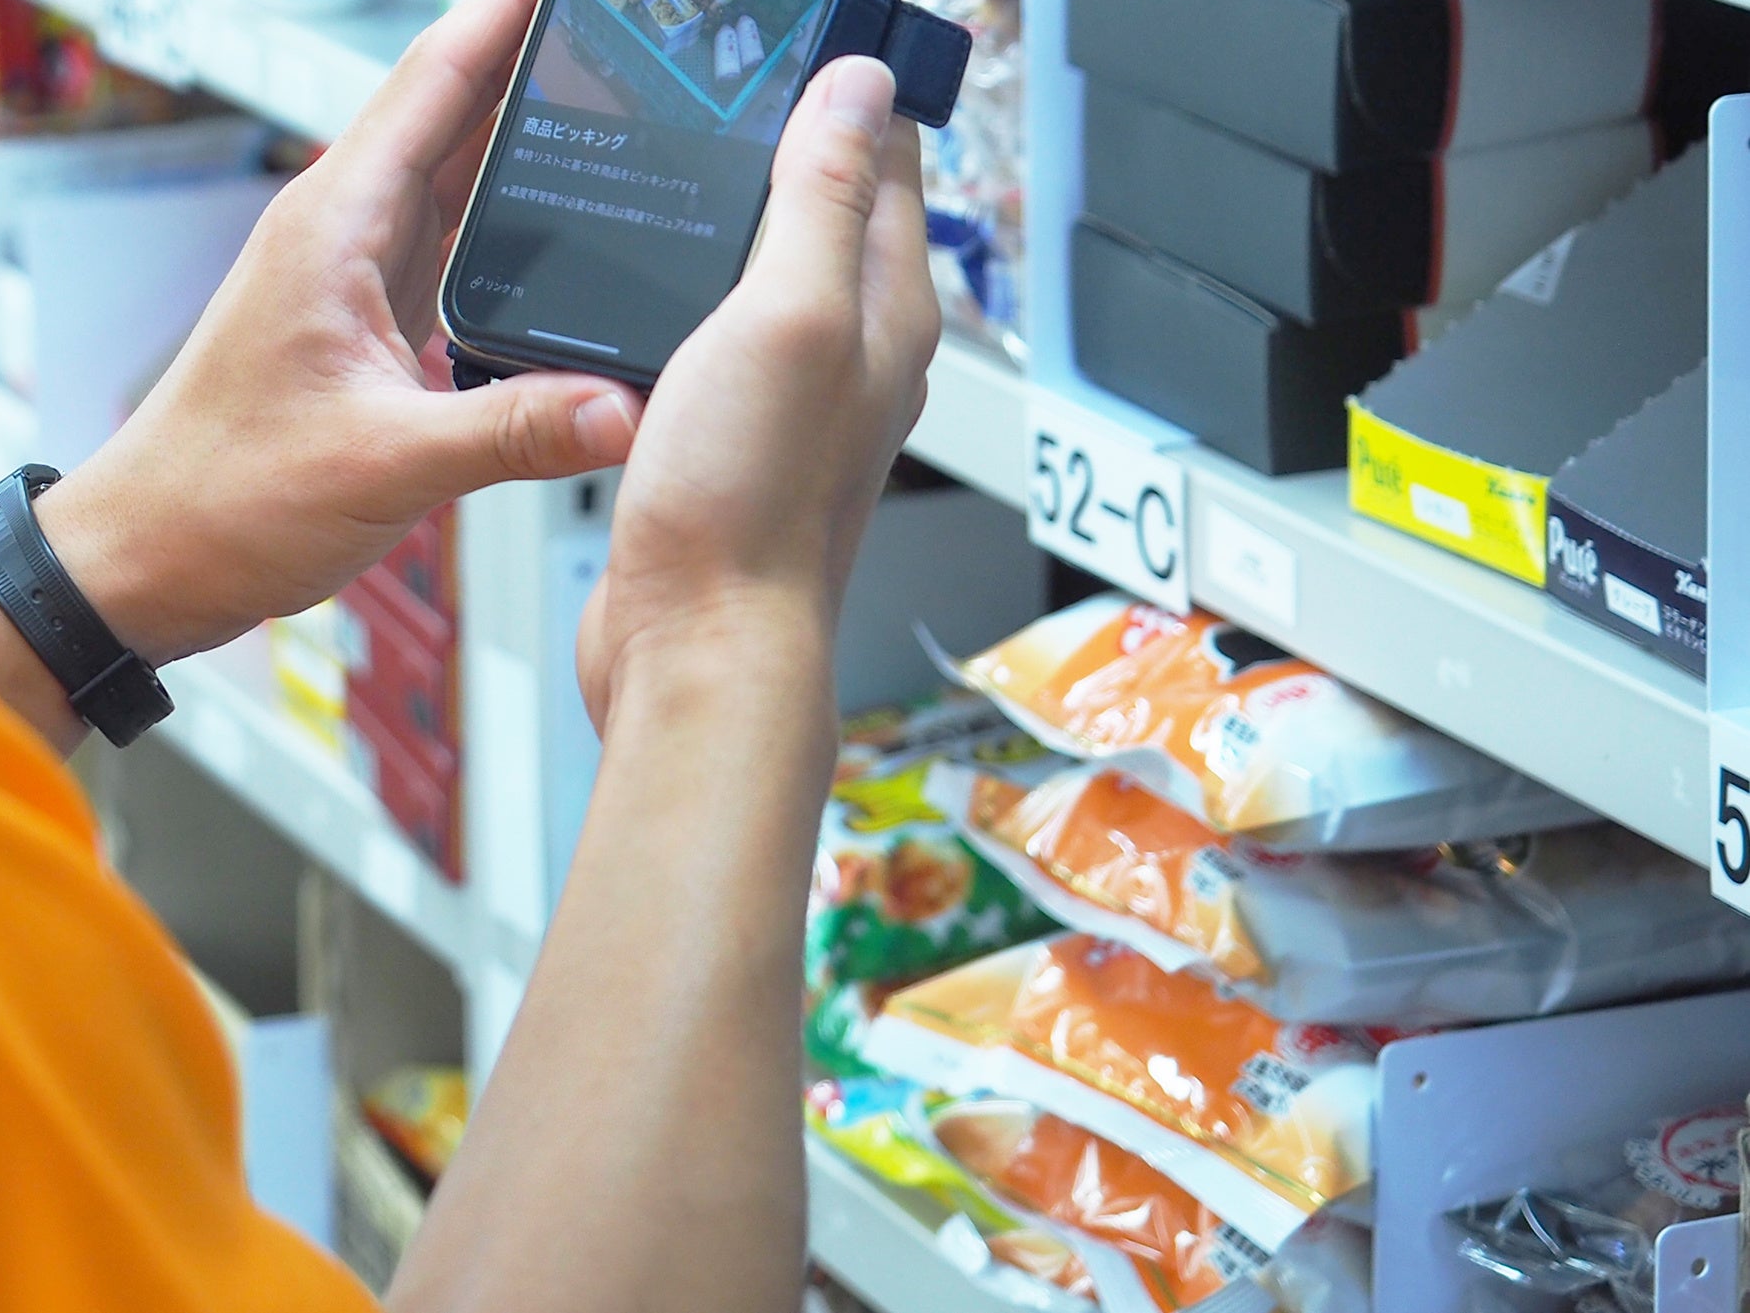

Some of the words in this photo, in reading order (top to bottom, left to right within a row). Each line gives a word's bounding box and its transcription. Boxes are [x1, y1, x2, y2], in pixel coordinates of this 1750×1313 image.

[522, 115, 628, 151] 商品ピッキング
[486, 280, 511, 294] リンク
[1032, 431, 1176, 581] 52-C
[1548, 515, 1599, 586] Puré
